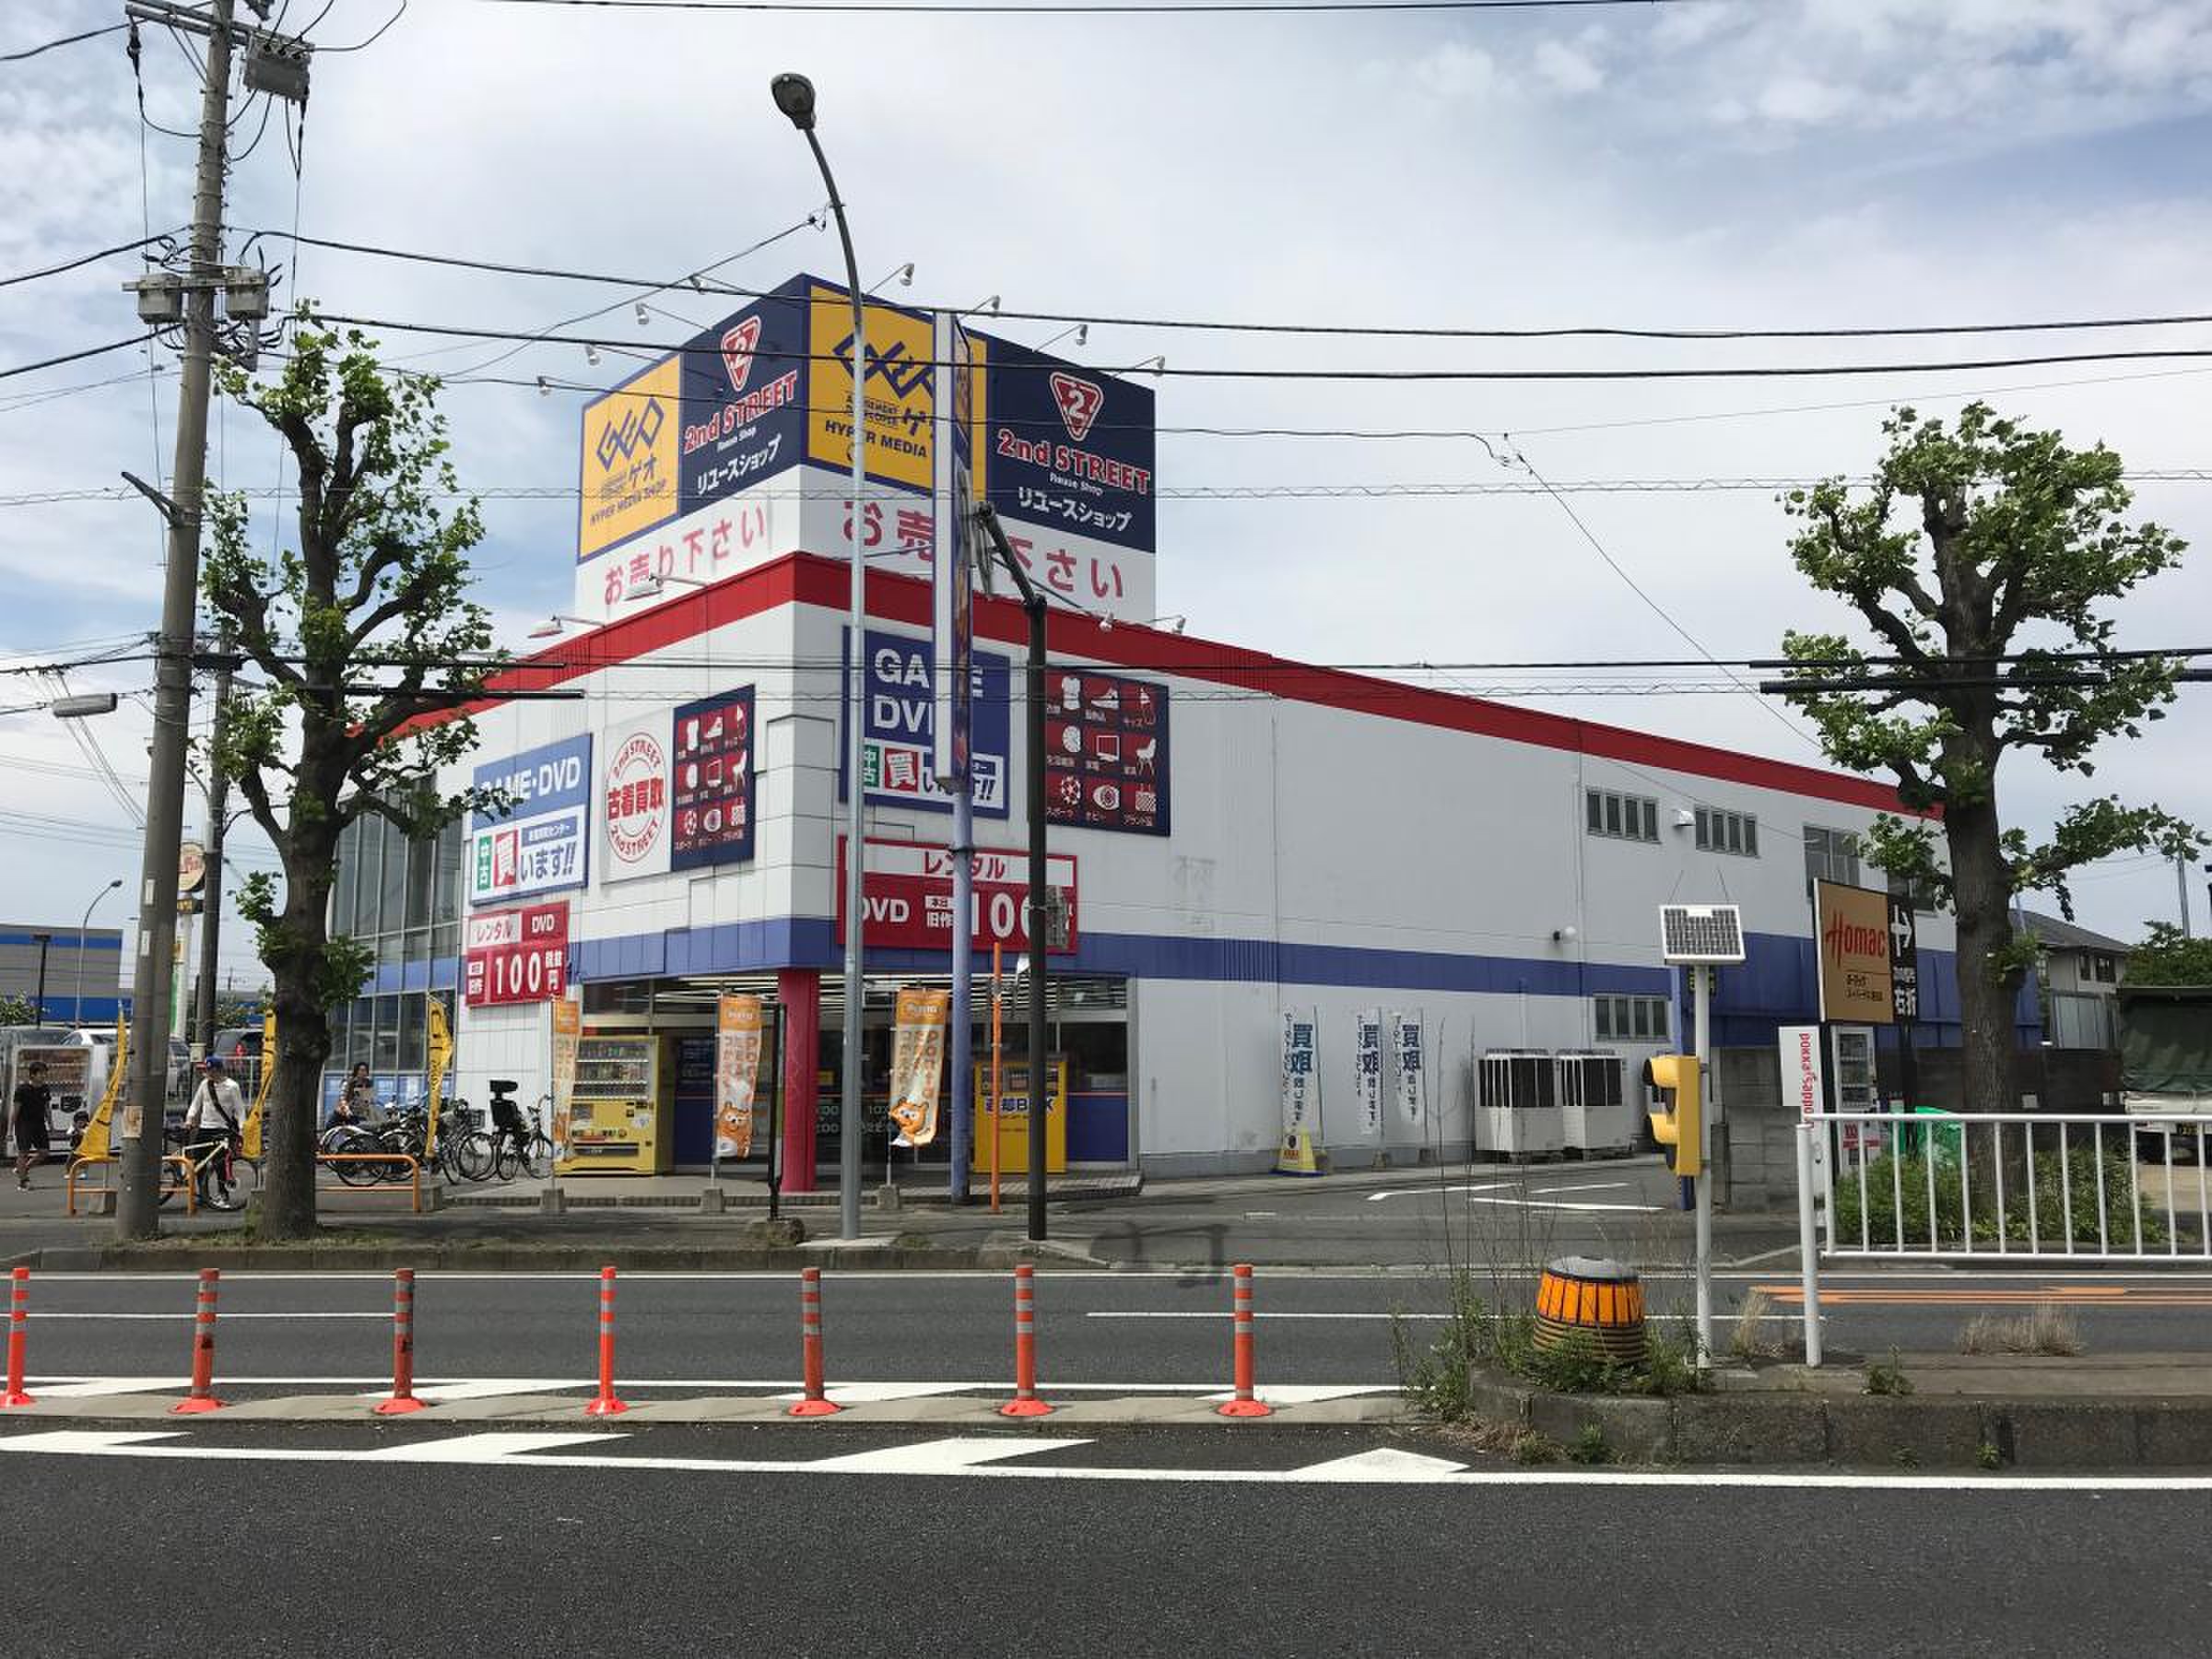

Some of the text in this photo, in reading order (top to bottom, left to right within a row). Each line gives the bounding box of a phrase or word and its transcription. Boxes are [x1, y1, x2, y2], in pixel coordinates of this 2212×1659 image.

[683, 370, 798, 455] 2nd STREET
[1067, 388, 1085, 418] 2
[696, 433, 782, 496] リユースショップ
[826, 420, 928, 458] HYPR MEDIA
[997, 428, 1151, 496] 2nd STREET
[1018, 486, 1133, 532] リユースショップ
[605, 505, 766, 606] お売り下さい
[531, 913, 556, 934] DVD
[1826, 910, 1886, 968] Homac
[495, 951, 541, 994] 100
